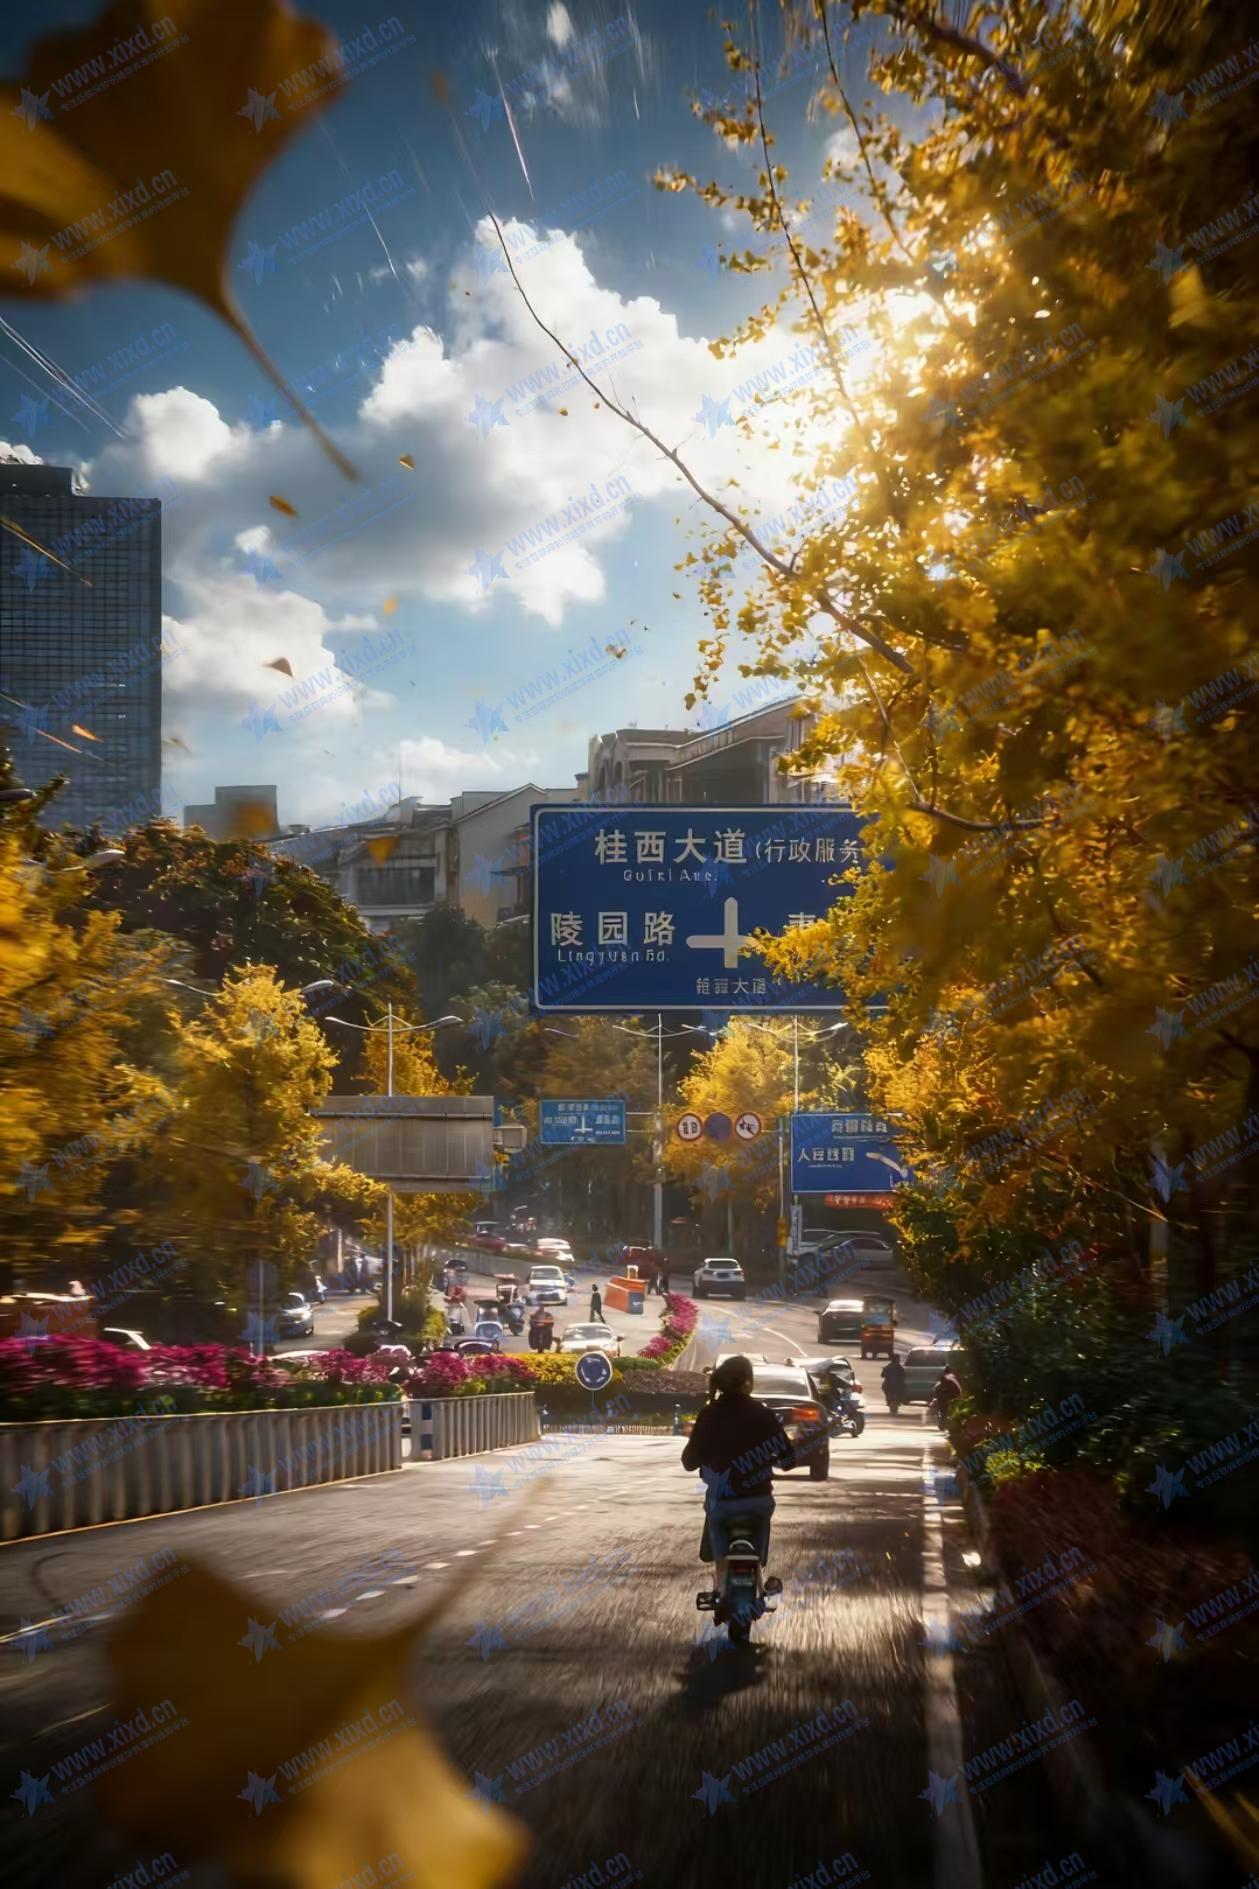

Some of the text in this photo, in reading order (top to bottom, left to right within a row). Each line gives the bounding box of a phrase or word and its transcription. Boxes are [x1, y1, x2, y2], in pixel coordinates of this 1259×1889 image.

[595, 828, 747, 864] 桂西大道
[550, 911, 675, 946] 陵园路
